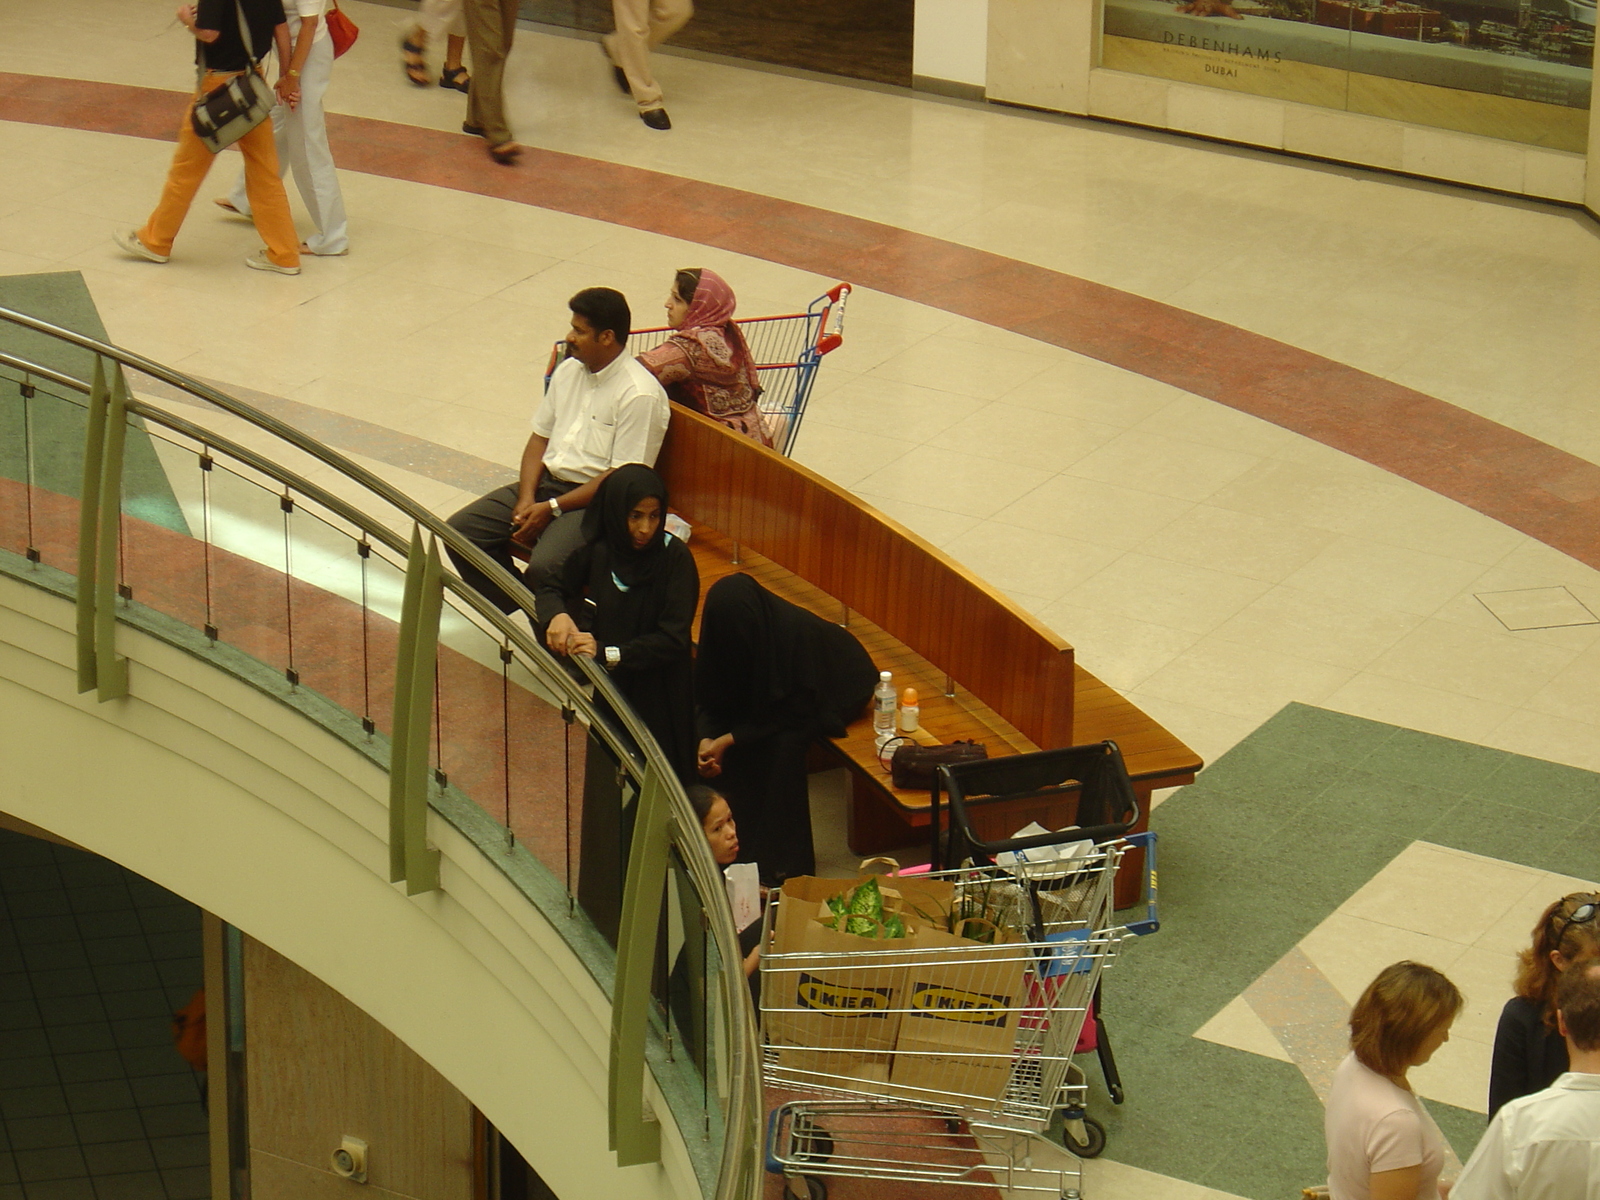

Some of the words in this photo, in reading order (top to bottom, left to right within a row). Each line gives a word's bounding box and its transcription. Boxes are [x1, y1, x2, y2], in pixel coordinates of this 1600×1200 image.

[1163, 31, 1281, 63] DEBENHAMS
[1204, 64, 1238, 77] DUBAI
[810, 987, 877, 1009] IKEA
[924, 994, 995, 1016] IKEA
